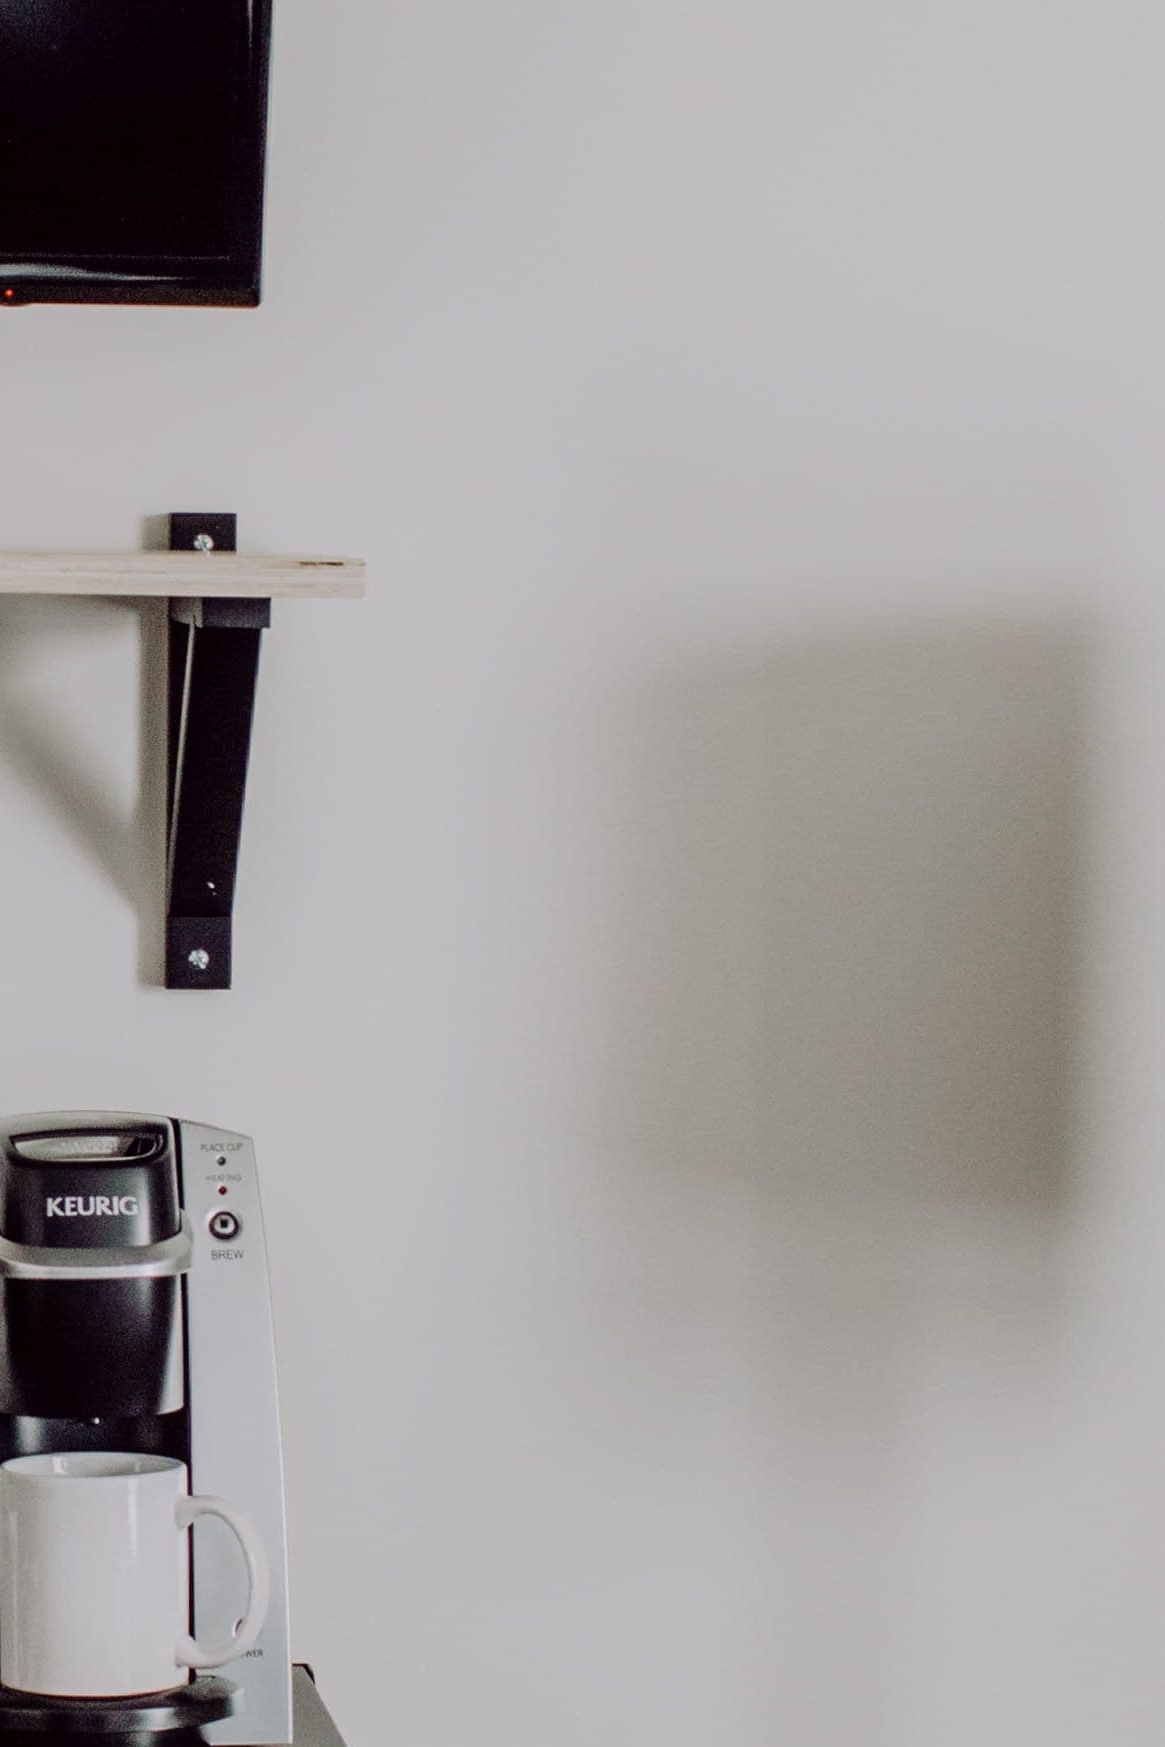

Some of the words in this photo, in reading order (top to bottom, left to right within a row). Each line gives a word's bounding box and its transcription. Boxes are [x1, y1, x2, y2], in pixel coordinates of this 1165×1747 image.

[200, 1143, 224, 1152] PLACE
[226, 1143, 243, 1151] CUP
[46, 1196, 139, 1217] KEURIG
[211, 1249, 244, 1260] BREW
